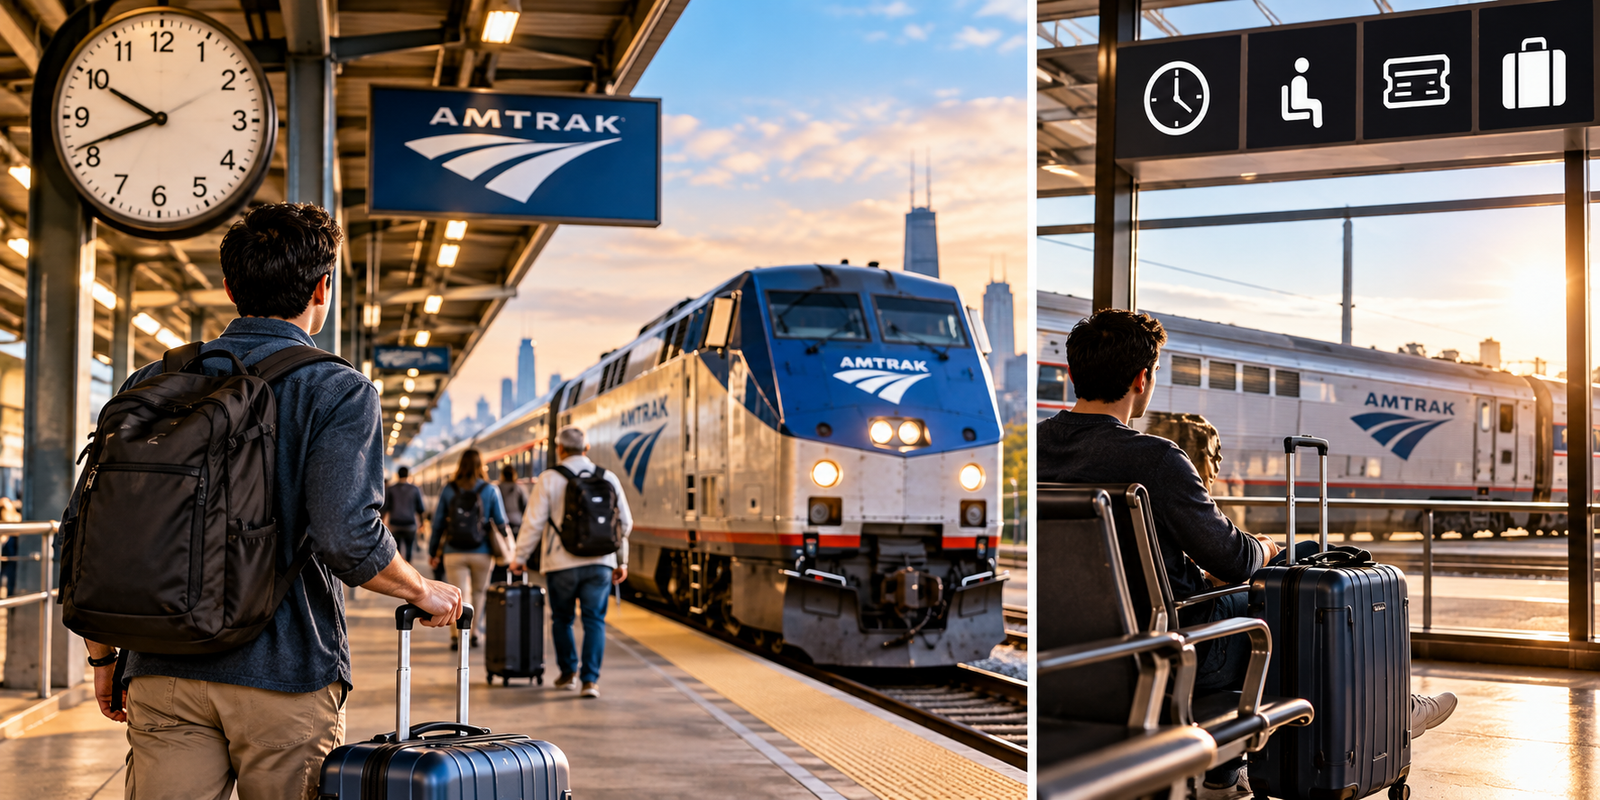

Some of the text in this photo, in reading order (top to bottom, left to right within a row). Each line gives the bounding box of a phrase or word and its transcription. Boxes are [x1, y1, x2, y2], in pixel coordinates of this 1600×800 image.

[114, 41, 132, 62] 11
[150, 31, 174, 53] 12
[197, 41, 205, 62] 1
[86, 68, 109, 90] 10
[221, 69, 236, 91] 2
[74, 106, 89, 128] 9
[232, 110, 247, 131] 3
[429, 106, 621, 134] AMTRAK
[86, 146, 100, 167] 8
[220, 149, 236, 170] 4
[114, 174, 129, 195] 7
[192, 176, 207, 198] 5
[152, 185, 167, 207] 6
[840, 356, 929, 373] AMTRAK
[620, 394, 668, 428] AMTRAK
[1364, 391, 1456, 416] AMTRAK
